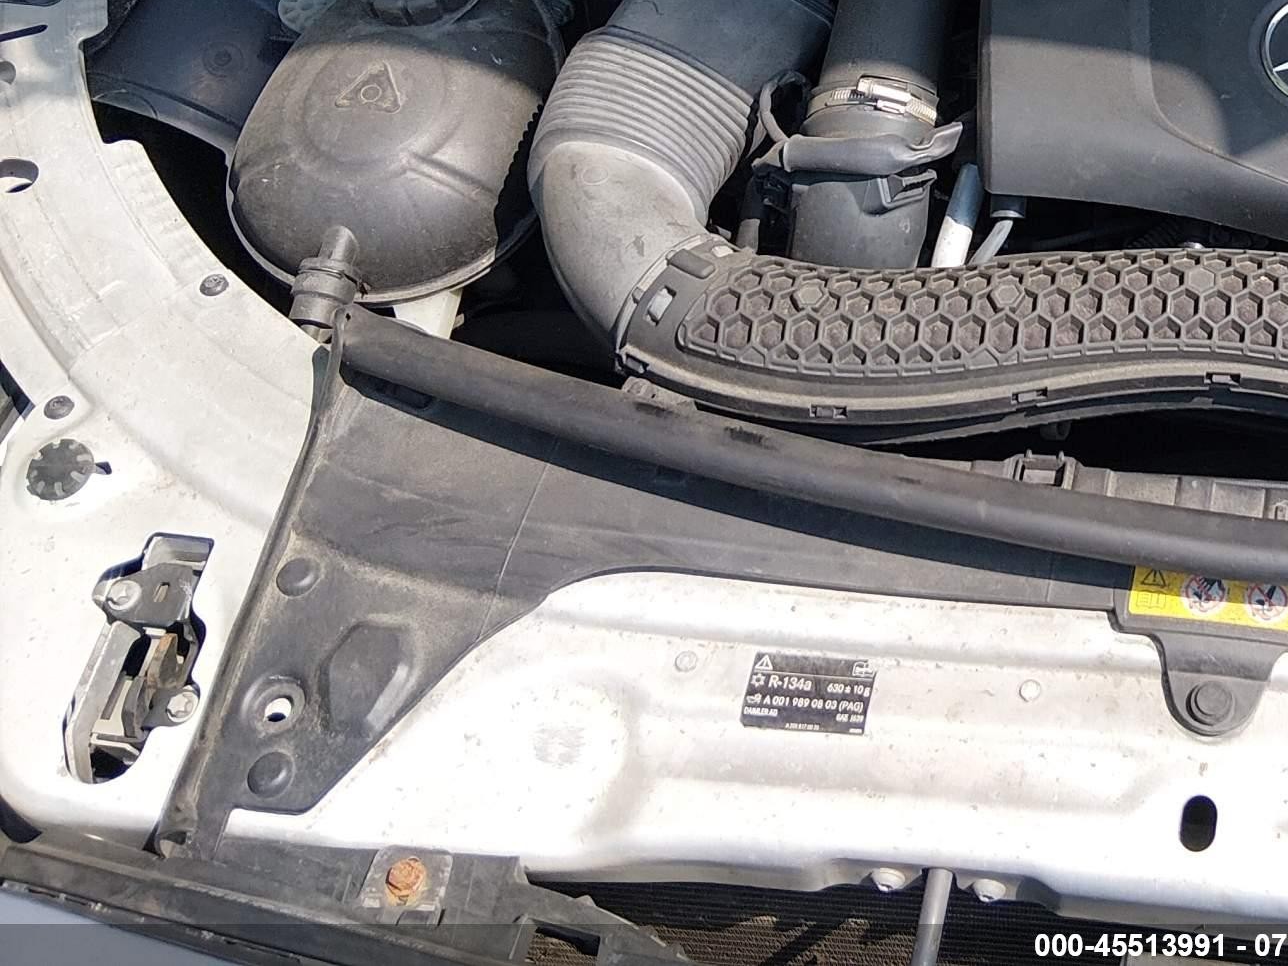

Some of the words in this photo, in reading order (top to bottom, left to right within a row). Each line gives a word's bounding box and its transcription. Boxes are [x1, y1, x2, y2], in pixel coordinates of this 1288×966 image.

[768, 675, 812, 691] R-134a
[827, 683, 844, 693] 630
[853, 685, 864, 694] 10
[864, 687, 871, 697] g
[763, 695, 770, 704] A
[772, 695, 789, 706] 001
[792, 697, 810, 708] 989
[811, 699, 823, 709] 08
[825, 700, 838, 710] 03
[838, 701, 864, 713] (PAG)
